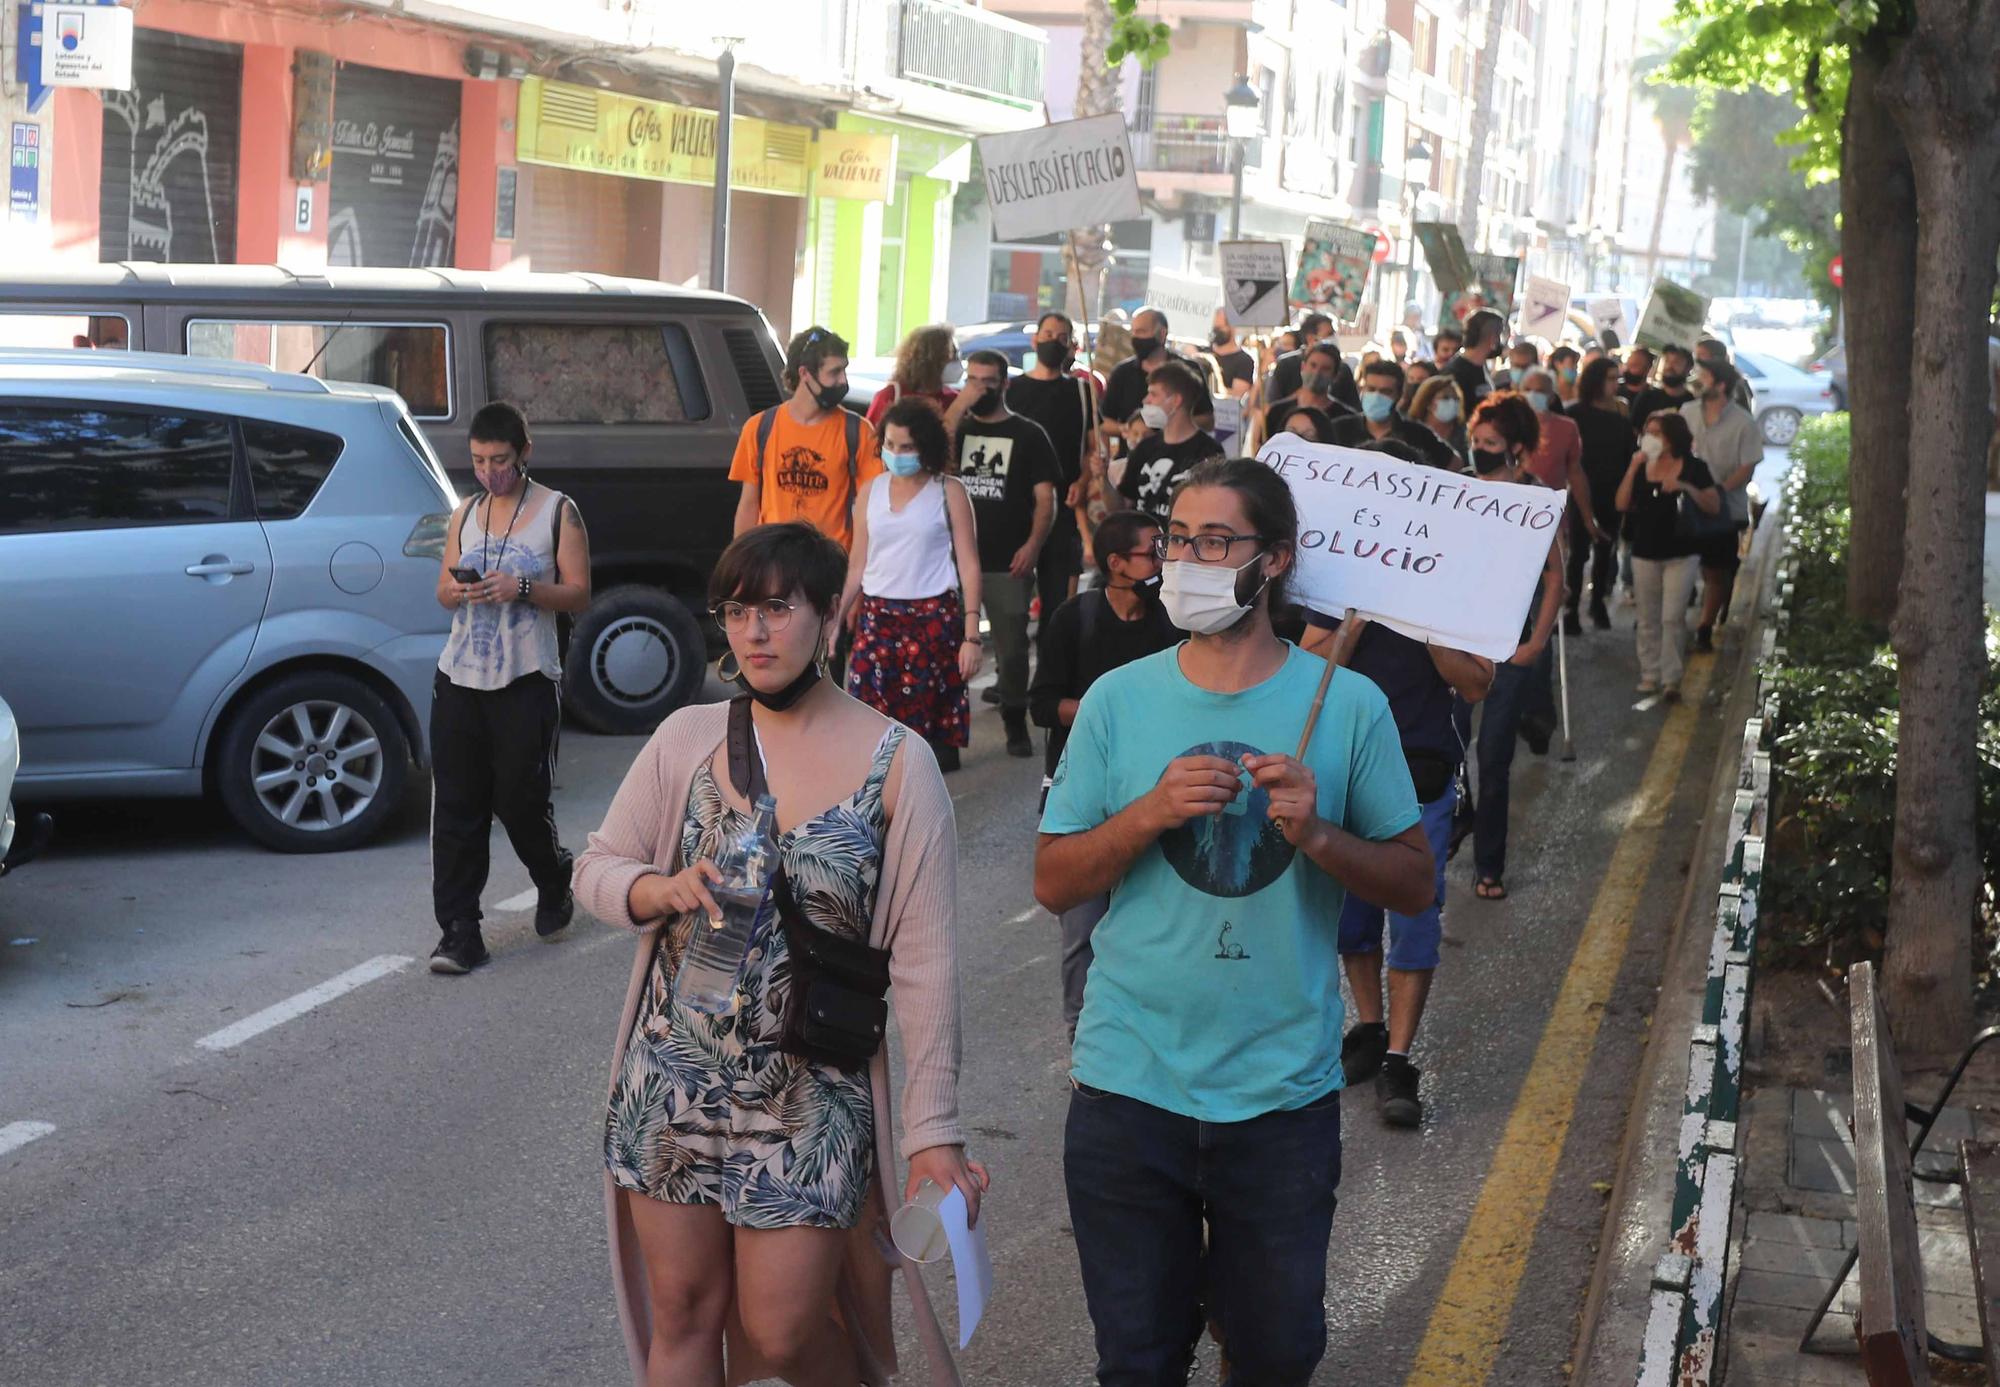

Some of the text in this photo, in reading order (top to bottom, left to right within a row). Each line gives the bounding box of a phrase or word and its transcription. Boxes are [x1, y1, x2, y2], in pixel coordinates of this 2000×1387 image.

[670, 113, 720, 159] VALIEN
[823, 163, 883, 183] VALIENTE
[299, 200, 309, 223] B
[1353, 507, 1430, 539] ÉS LA
[1299, 529, 1444, 575] OLUCIÓ
